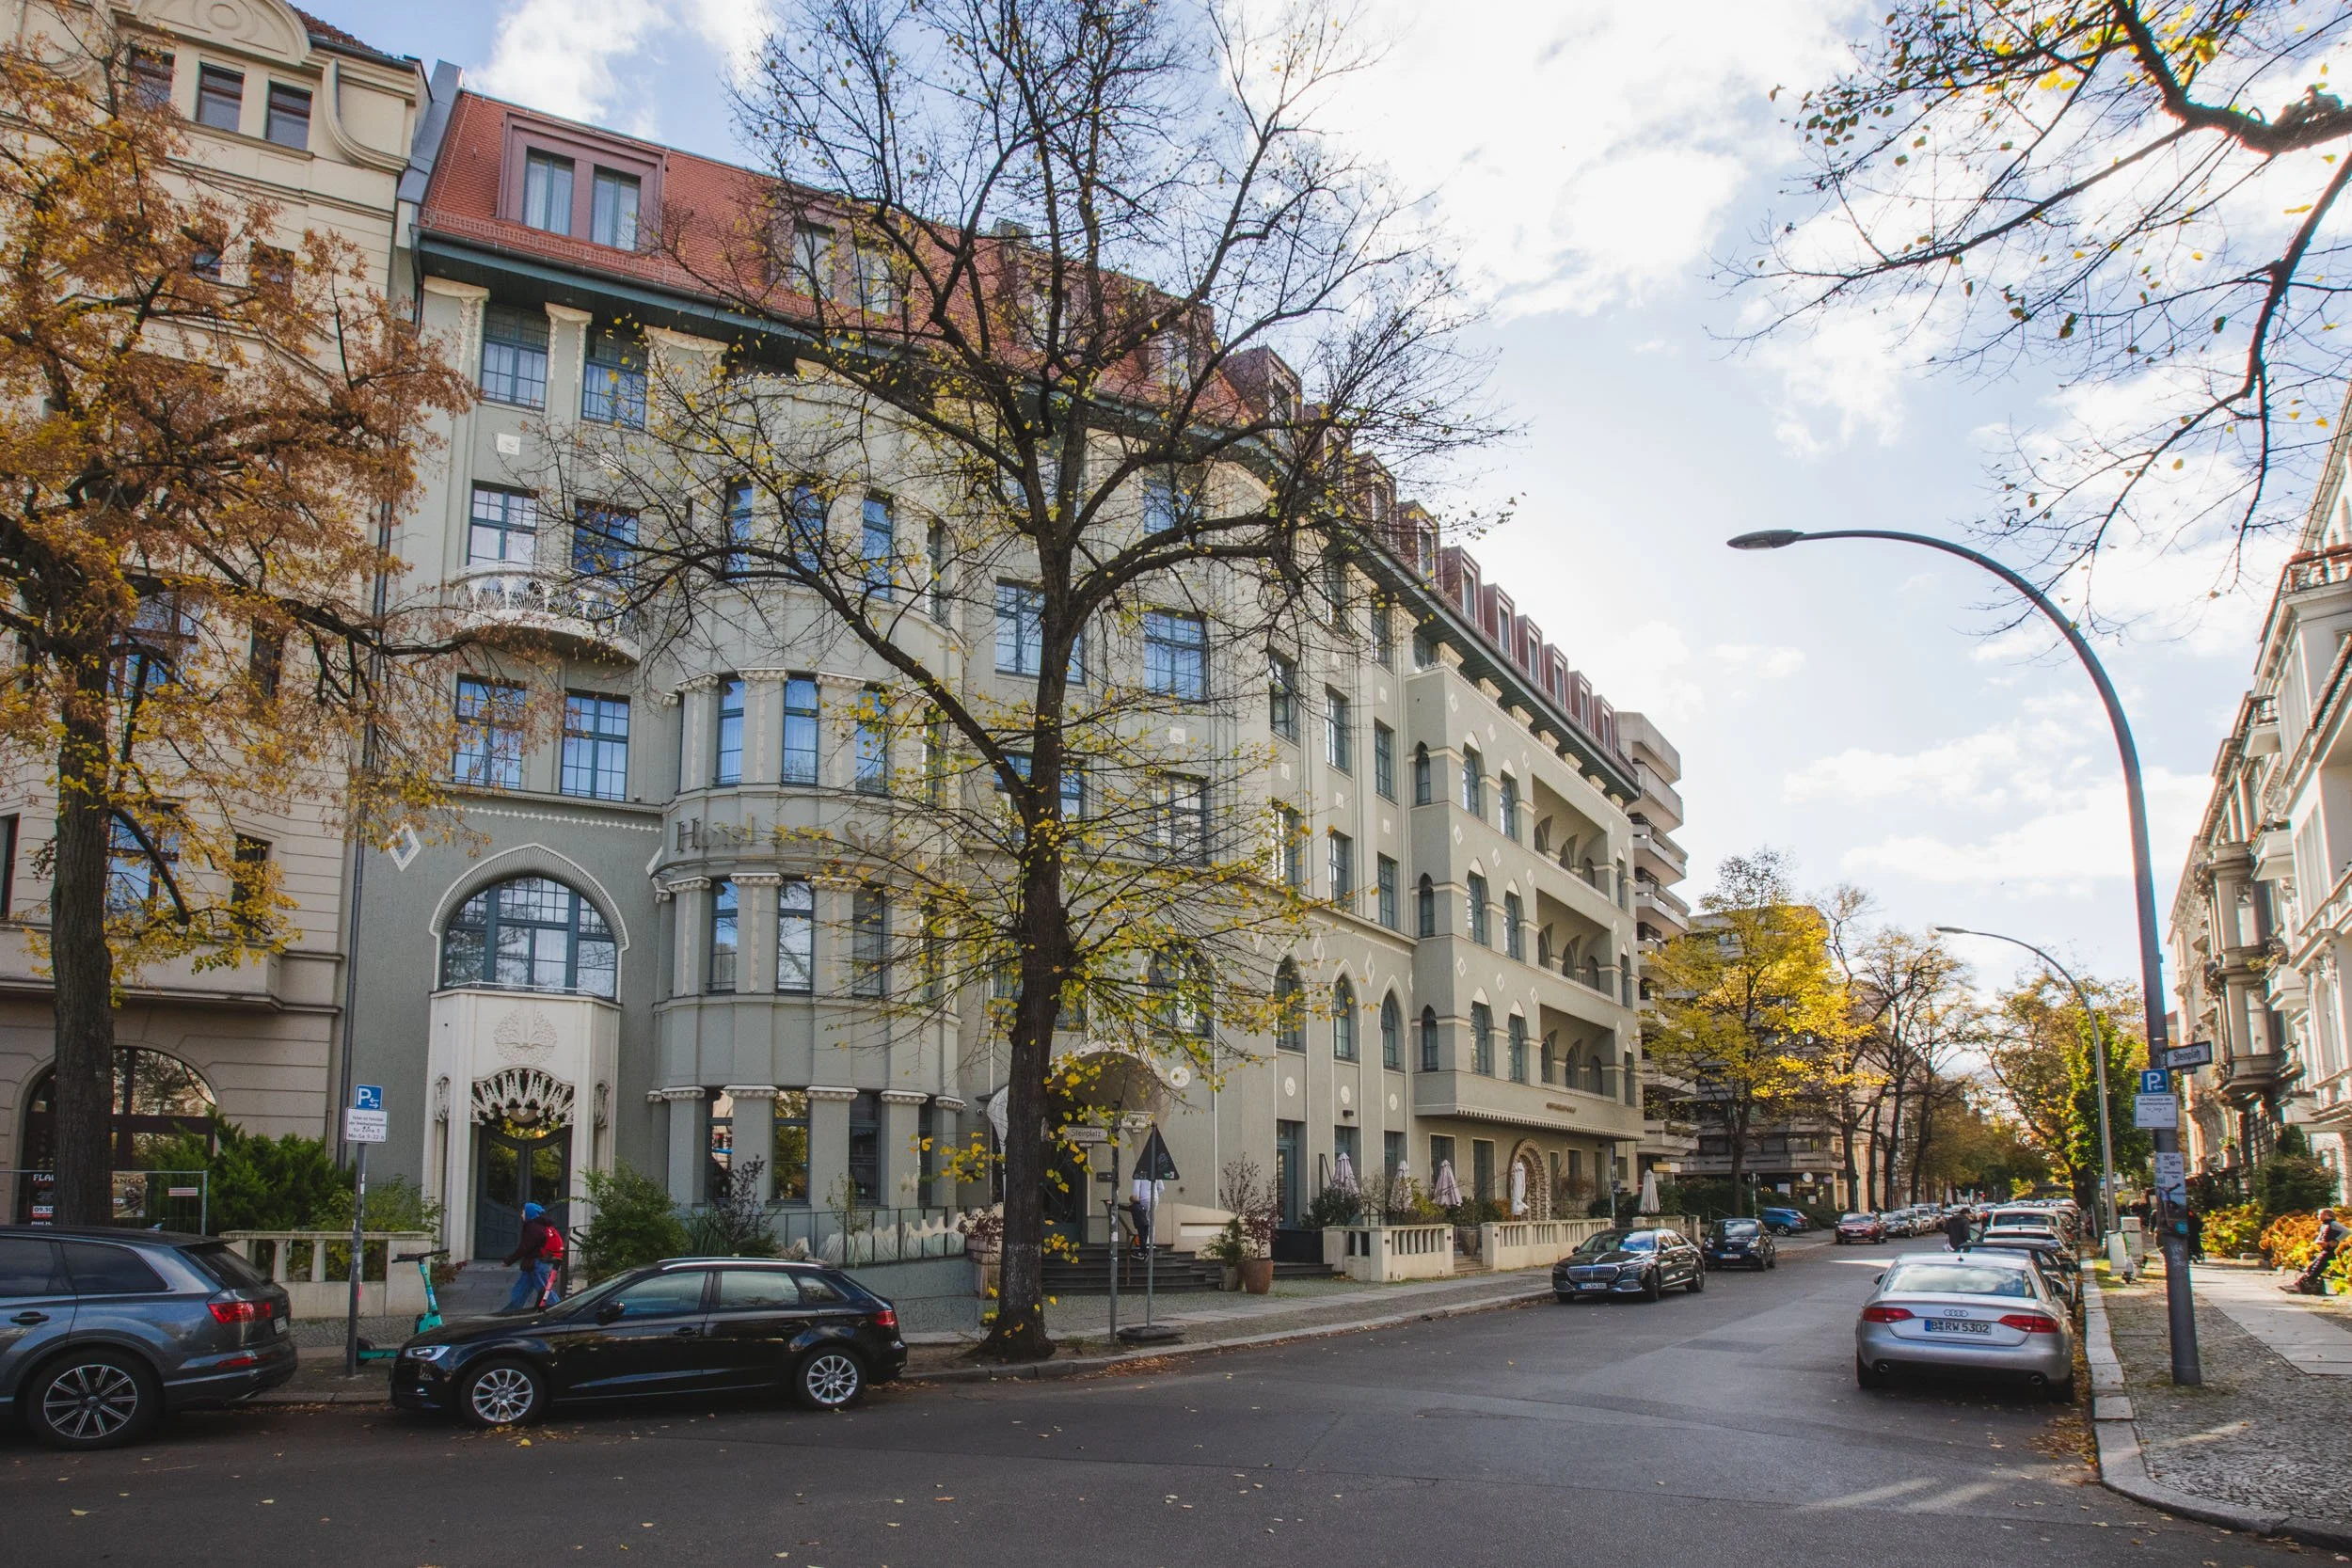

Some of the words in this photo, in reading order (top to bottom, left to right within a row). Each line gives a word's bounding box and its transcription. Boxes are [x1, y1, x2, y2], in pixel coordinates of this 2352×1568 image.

[2147, 1072, 2161, 1091] P
[358, 1087, 372, 1105] P
[1071, 1128, 1102, 1138] Steinplatz
[33, 1173, 55, 1181] FLA
[1962, 1323, 1990, 1334] 5302
